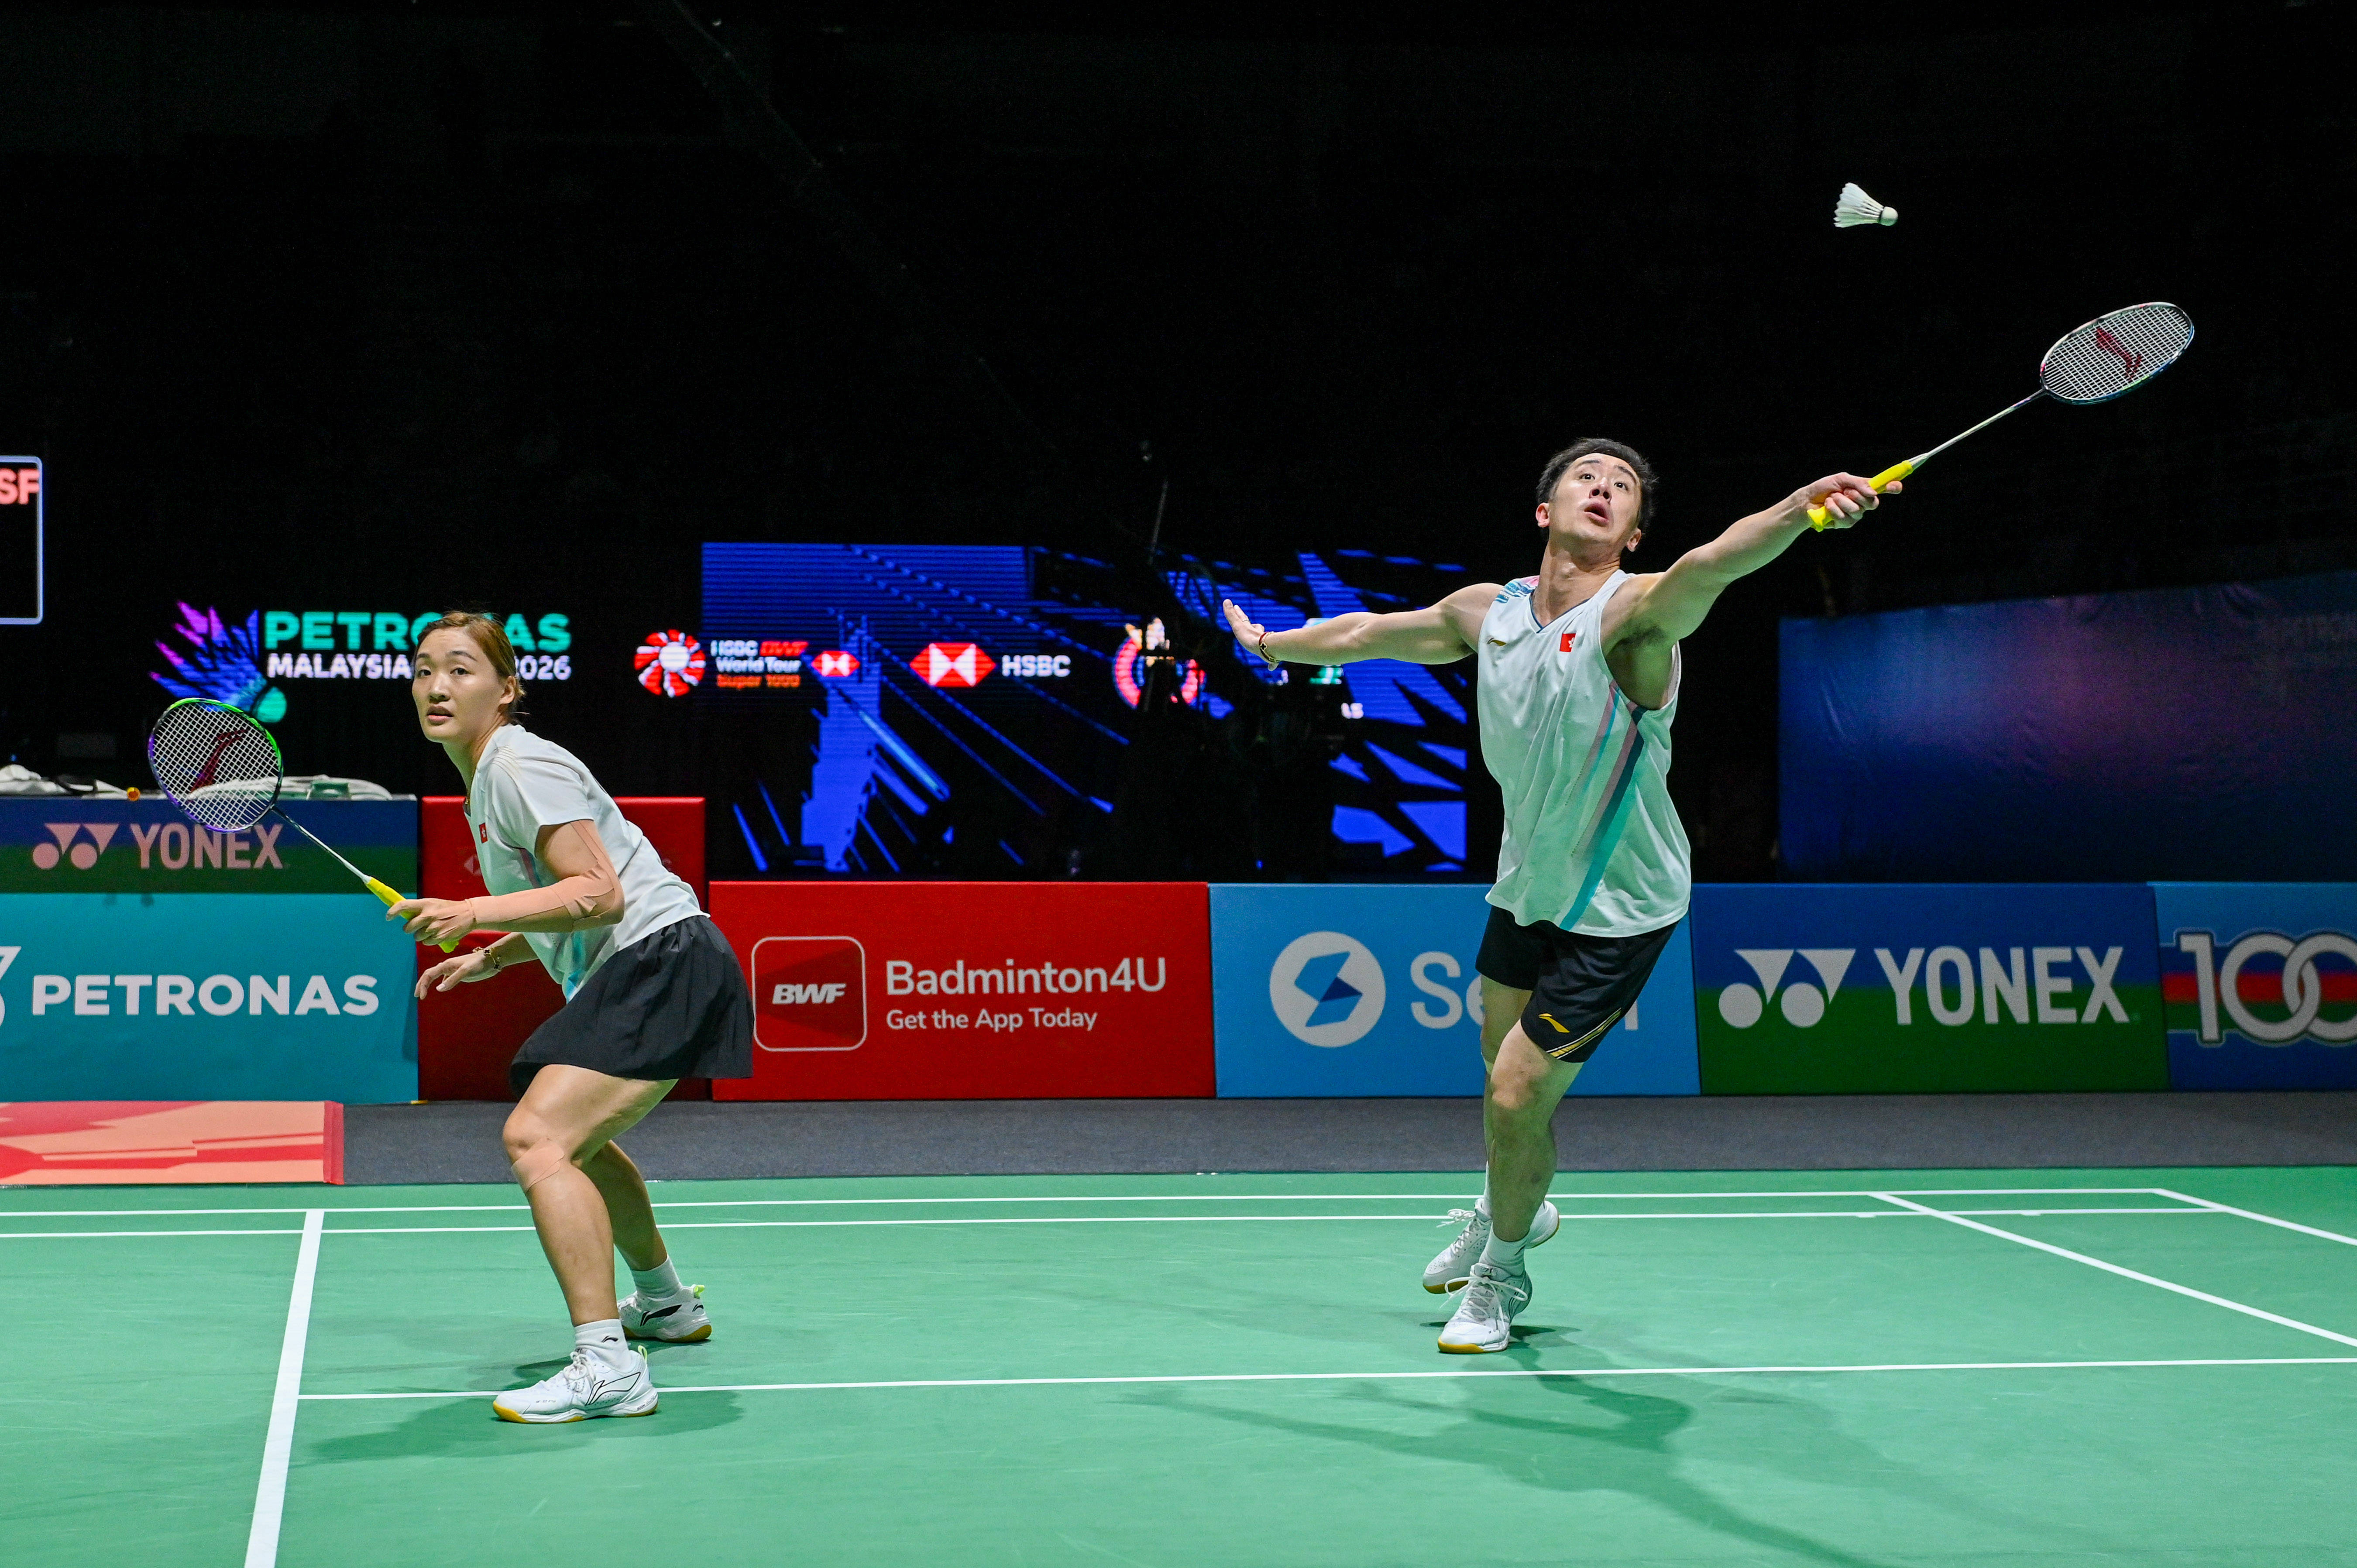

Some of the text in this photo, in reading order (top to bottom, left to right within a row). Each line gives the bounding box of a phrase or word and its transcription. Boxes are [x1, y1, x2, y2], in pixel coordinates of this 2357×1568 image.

[265, 611, 570, 652] PETRAS
[268, 653, 572, 680] MALAYSIA 026
[716, 656, 801, 673] World Tour
[1002, 655, 1071, 677] HSBC
[131, 823, 283, 870] YONEX
[886, 957, 1166, 995] Badminton4U
[1874, 946, 2130, 1026] YONEX
[32, 974, 379, 1016] PETRONAS
[772, 983, 846, 1004] BWF
[886, 1007, 1098, 1033] Get the App Today
